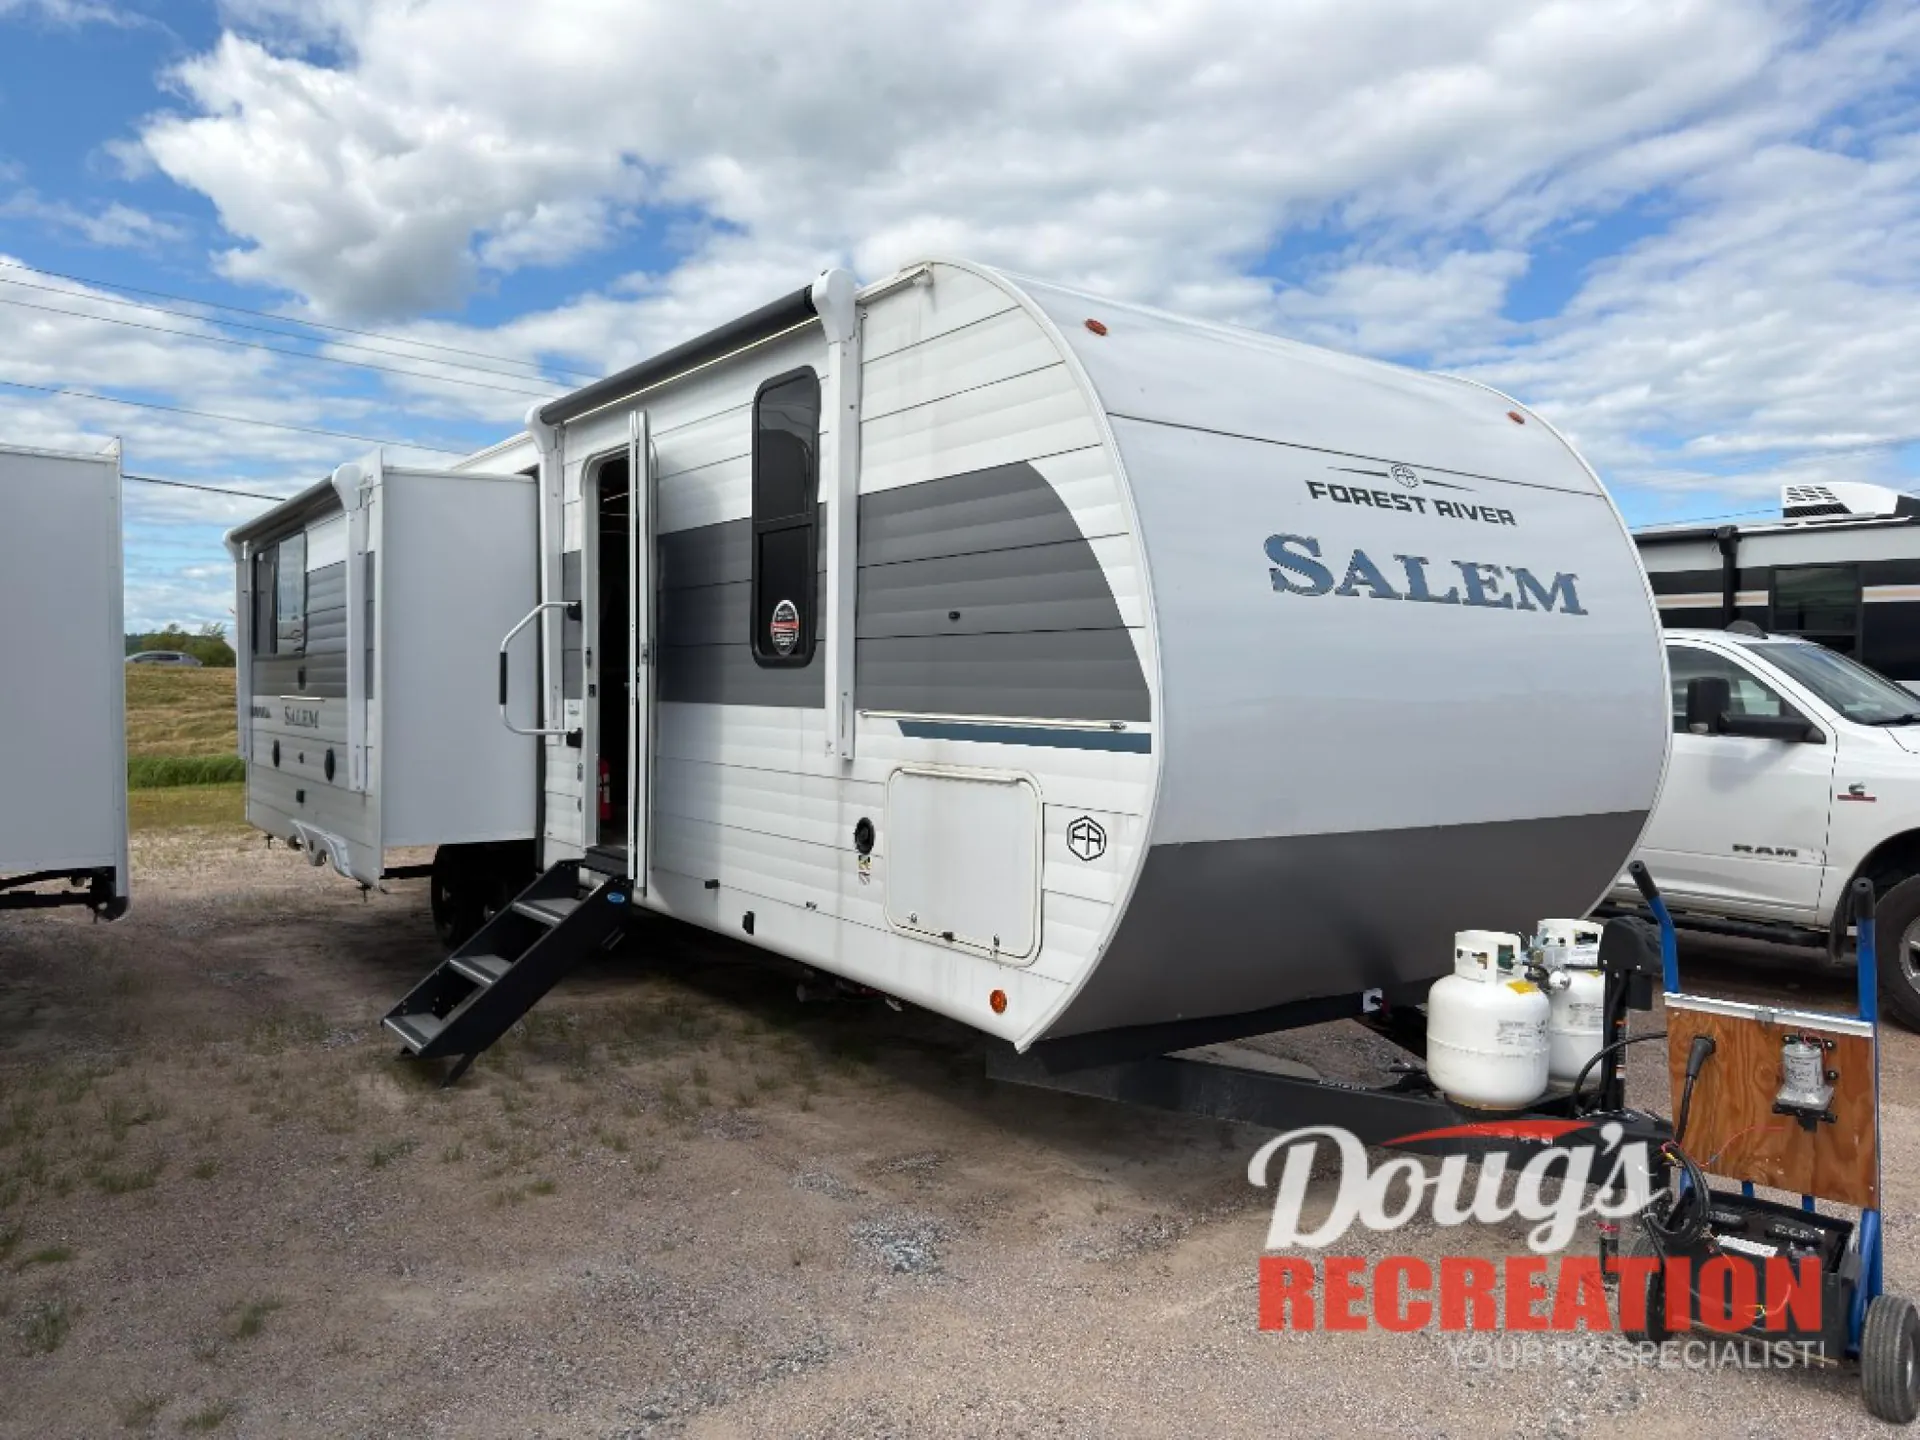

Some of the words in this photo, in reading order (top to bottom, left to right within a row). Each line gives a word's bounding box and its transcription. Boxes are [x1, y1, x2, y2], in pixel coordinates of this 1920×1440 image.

[1306, 480, 1427, 515] FOREST
[1432, 498, 1518, 527] RIVER
[1264, 533, 1589, 616] SALEM
[284, 705, 319, 728] SALEM
[1732, 845, 1797, 857] RAM
